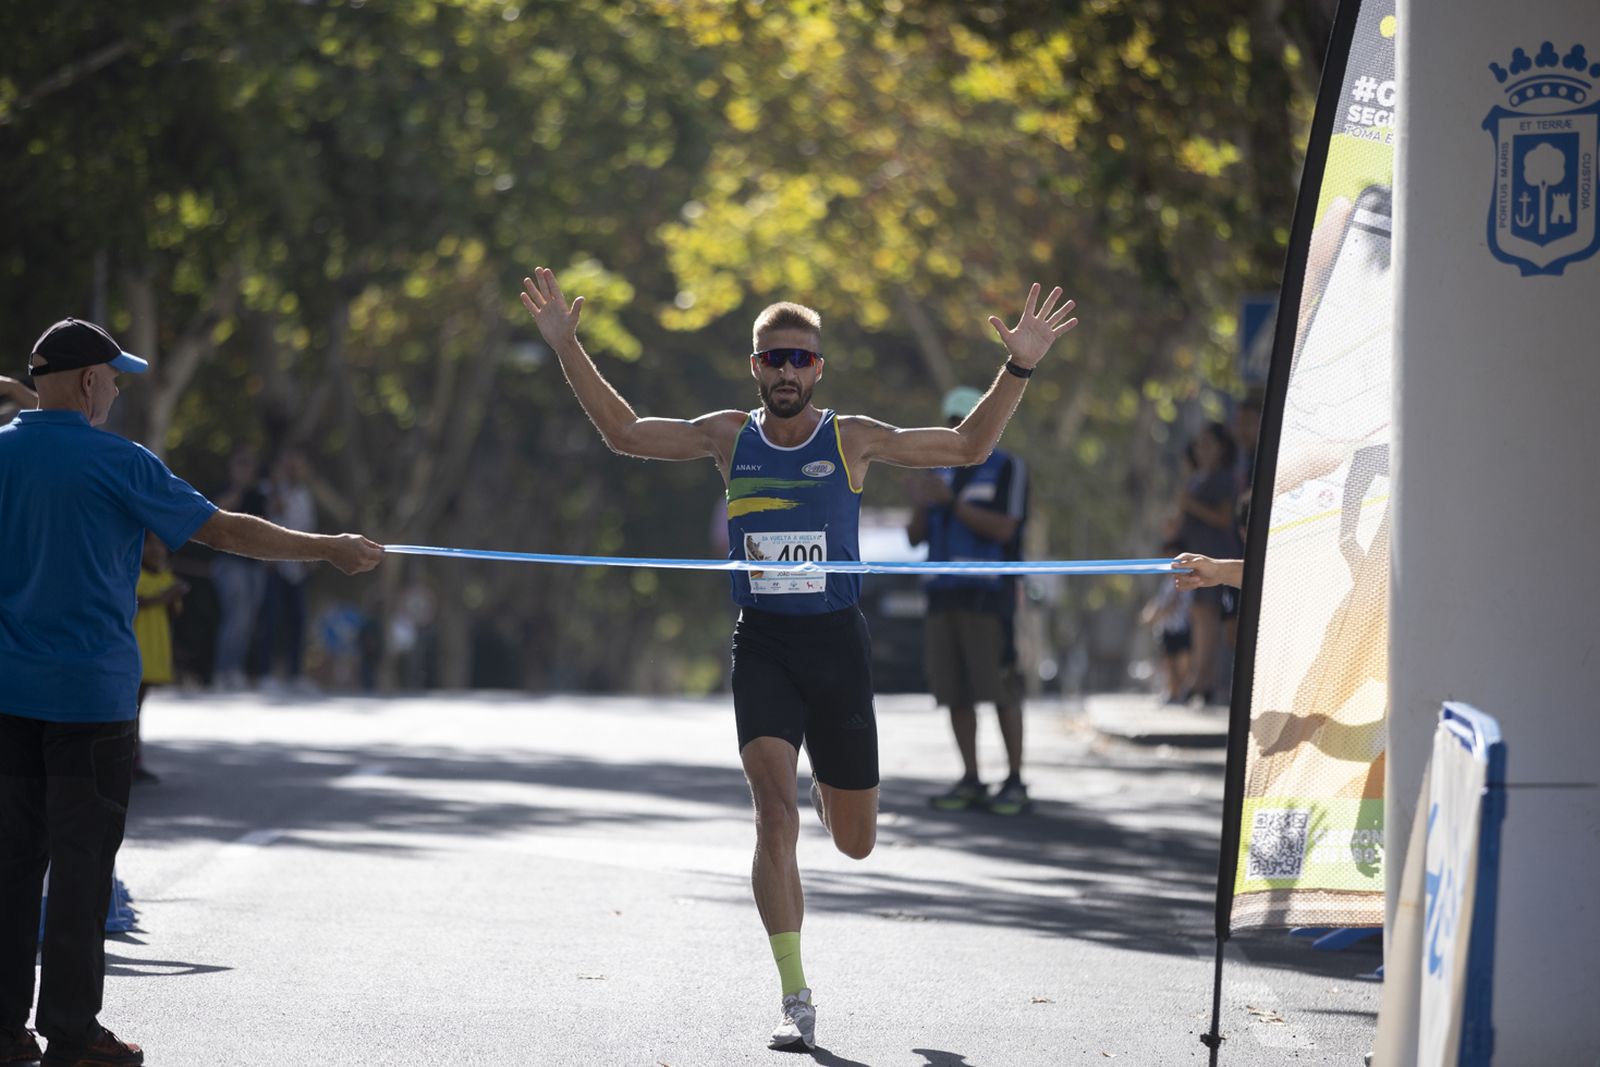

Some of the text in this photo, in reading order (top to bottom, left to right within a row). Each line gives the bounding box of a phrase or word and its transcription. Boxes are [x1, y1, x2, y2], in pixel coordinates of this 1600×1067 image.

[1344, 123, 1380, 140] TOMA
[1519, 120, 1532, 131] ET
[1499, 142, 1510, 228] PORTUS MARIS
[1581, 153, 1592, 210] CUSTODIA
[735, 464, 762, 472] ANAKY
[778, 544, 823, 562] 400
